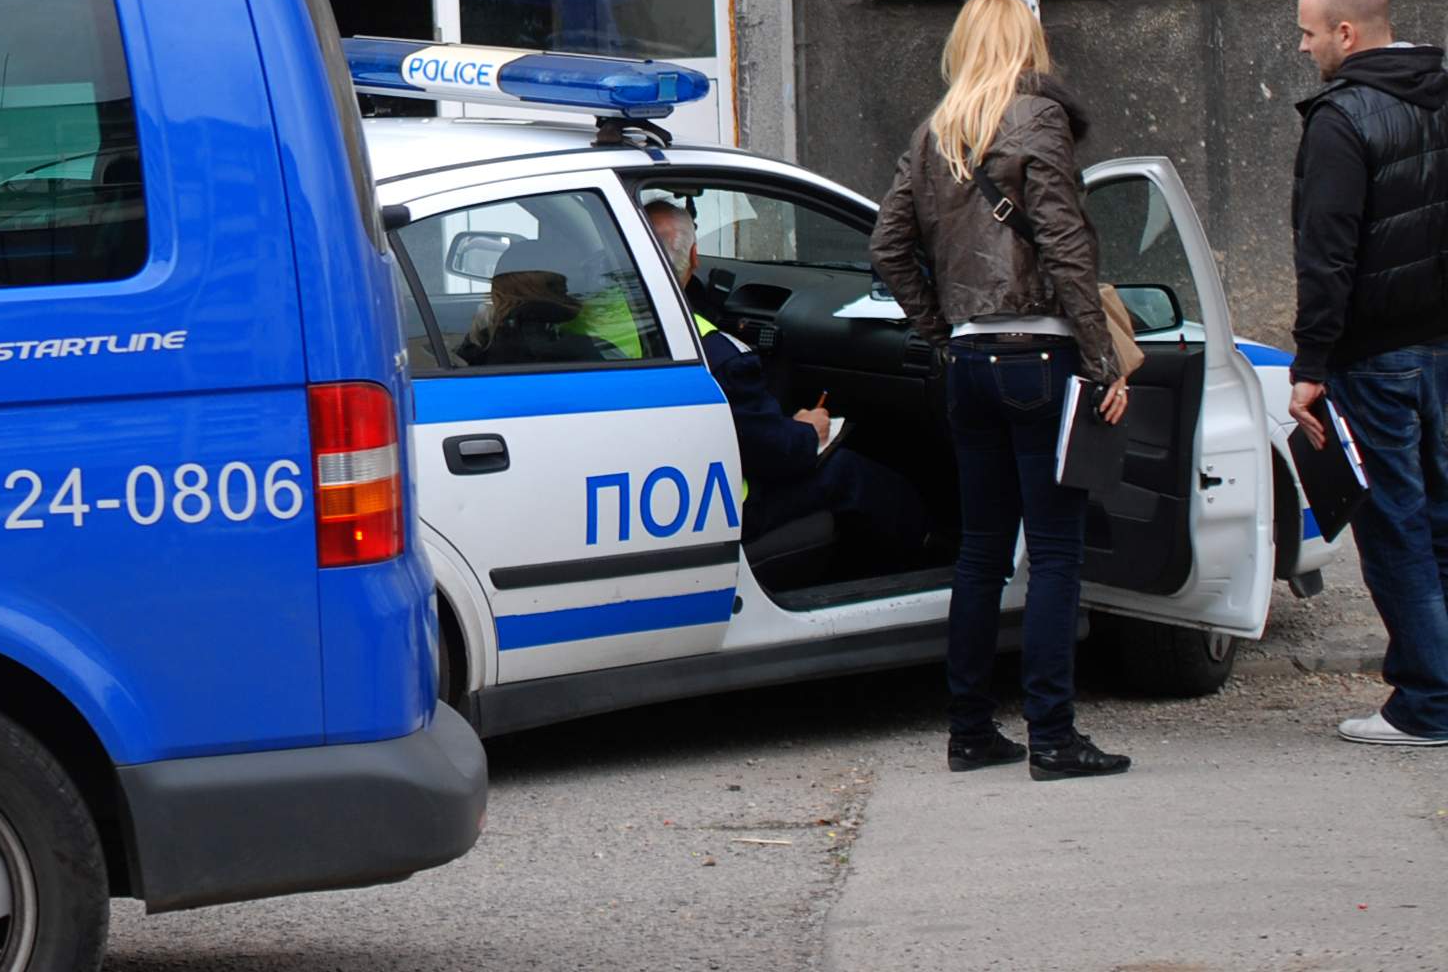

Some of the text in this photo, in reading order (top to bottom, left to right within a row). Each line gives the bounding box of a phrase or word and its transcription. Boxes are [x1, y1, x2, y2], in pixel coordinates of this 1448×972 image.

[409, 57, 493, 86] POLICE
[4, 460, 304, 530] 24-0806
[586, 461, 740, 545] ПОЛ
